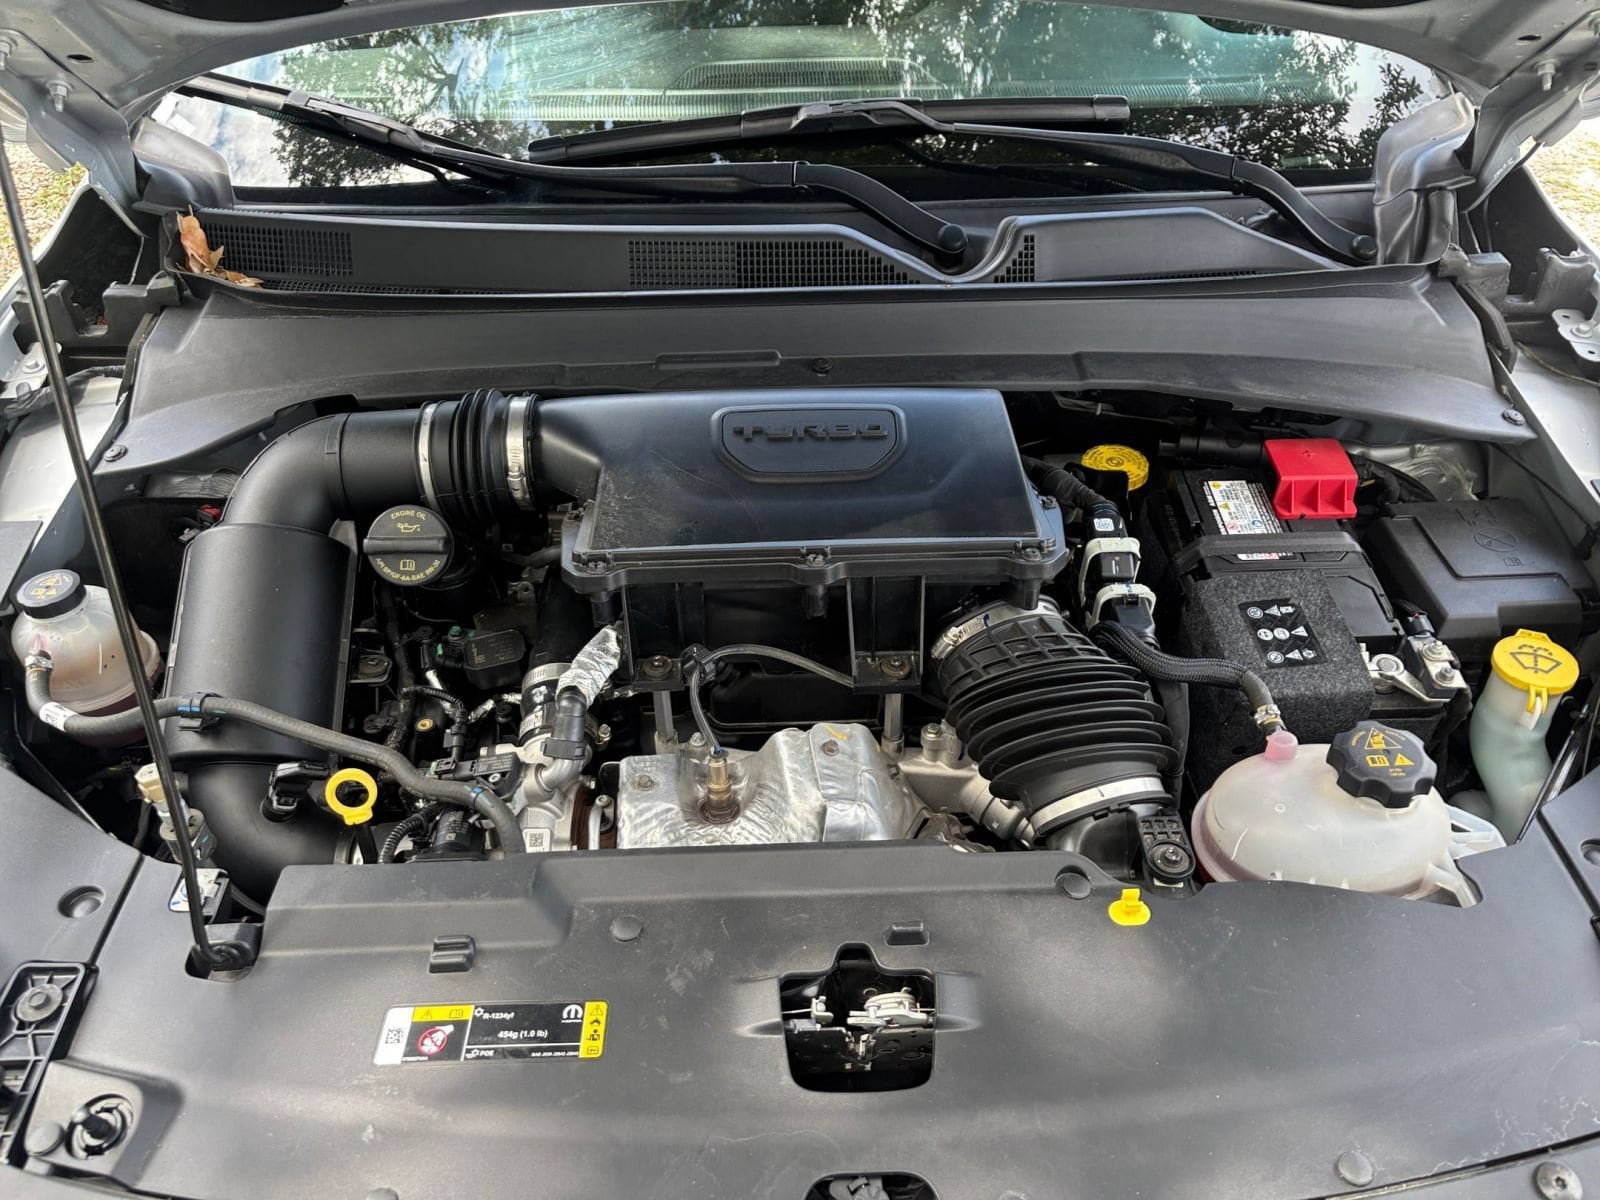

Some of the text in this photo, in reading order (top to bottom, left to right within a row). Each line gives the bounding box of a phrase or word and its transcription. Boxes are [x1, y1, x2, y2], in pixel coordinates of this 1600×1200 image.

[733, 422, 889, 442] TURBO
[390, 510, 426, 520] ENGINE OIL
[482, 1012, 515, 1020] R-1234yf
[497, 1029, 548, 1039] 454g (1.0 lb)
